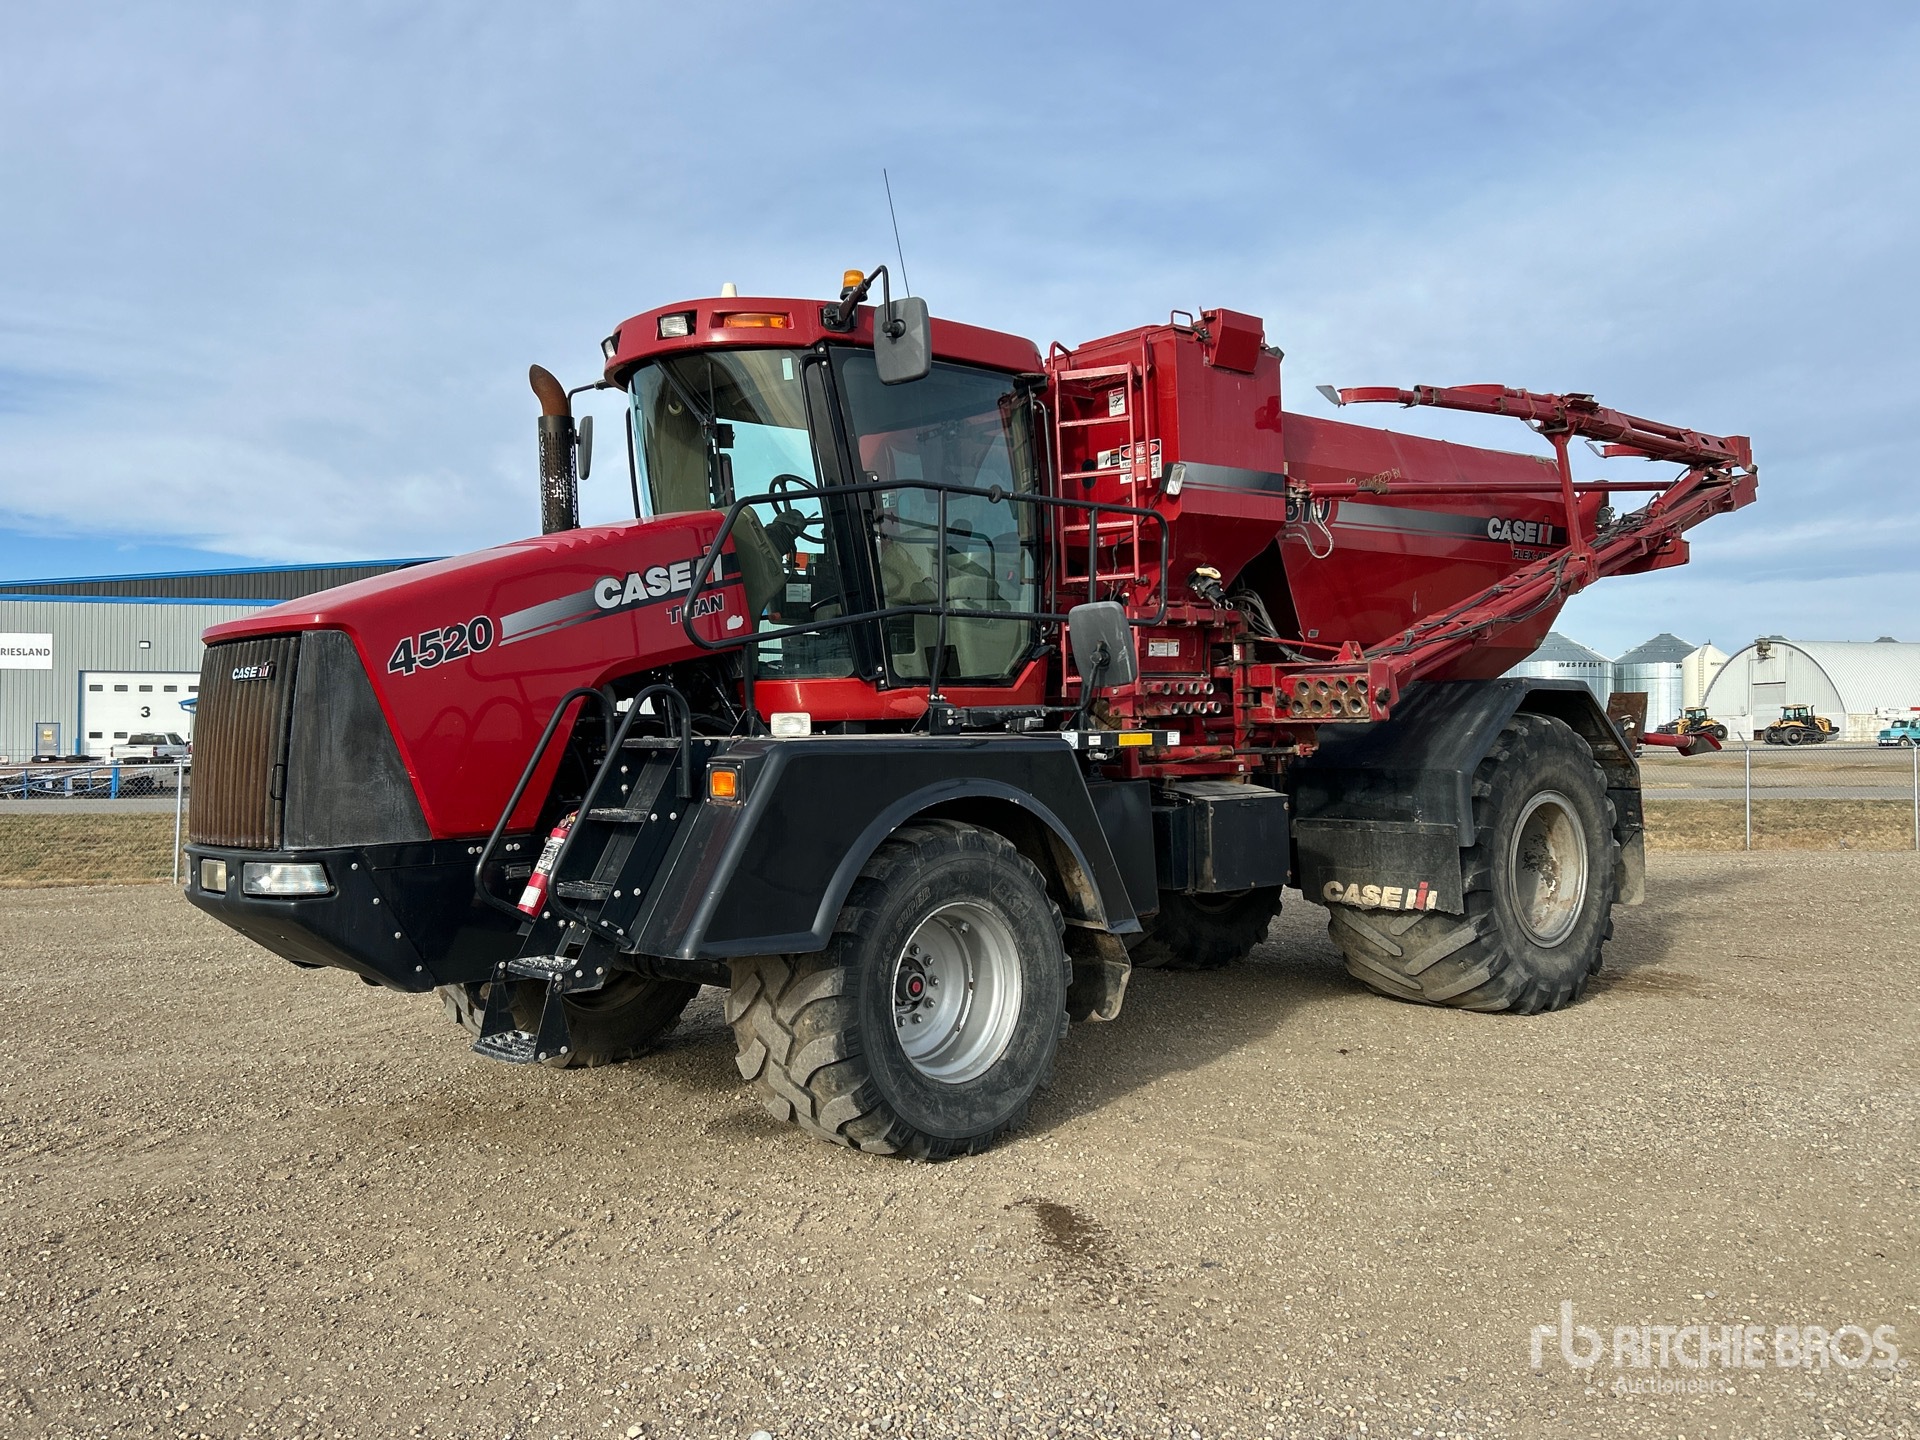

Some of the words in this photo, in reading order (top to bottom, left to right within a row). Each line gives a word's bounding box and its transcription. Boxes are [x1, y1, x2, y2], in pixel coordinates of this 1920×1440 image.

[1487, 517, 1537, 543] CASE
[594, 561, 692, 609] CASE
[387, 615, 495, 677] 4520
[232, 666, 258, 680] CASE
[140, 706, 151, 718] 3
[1322, 880, 1403, 909] CASE
